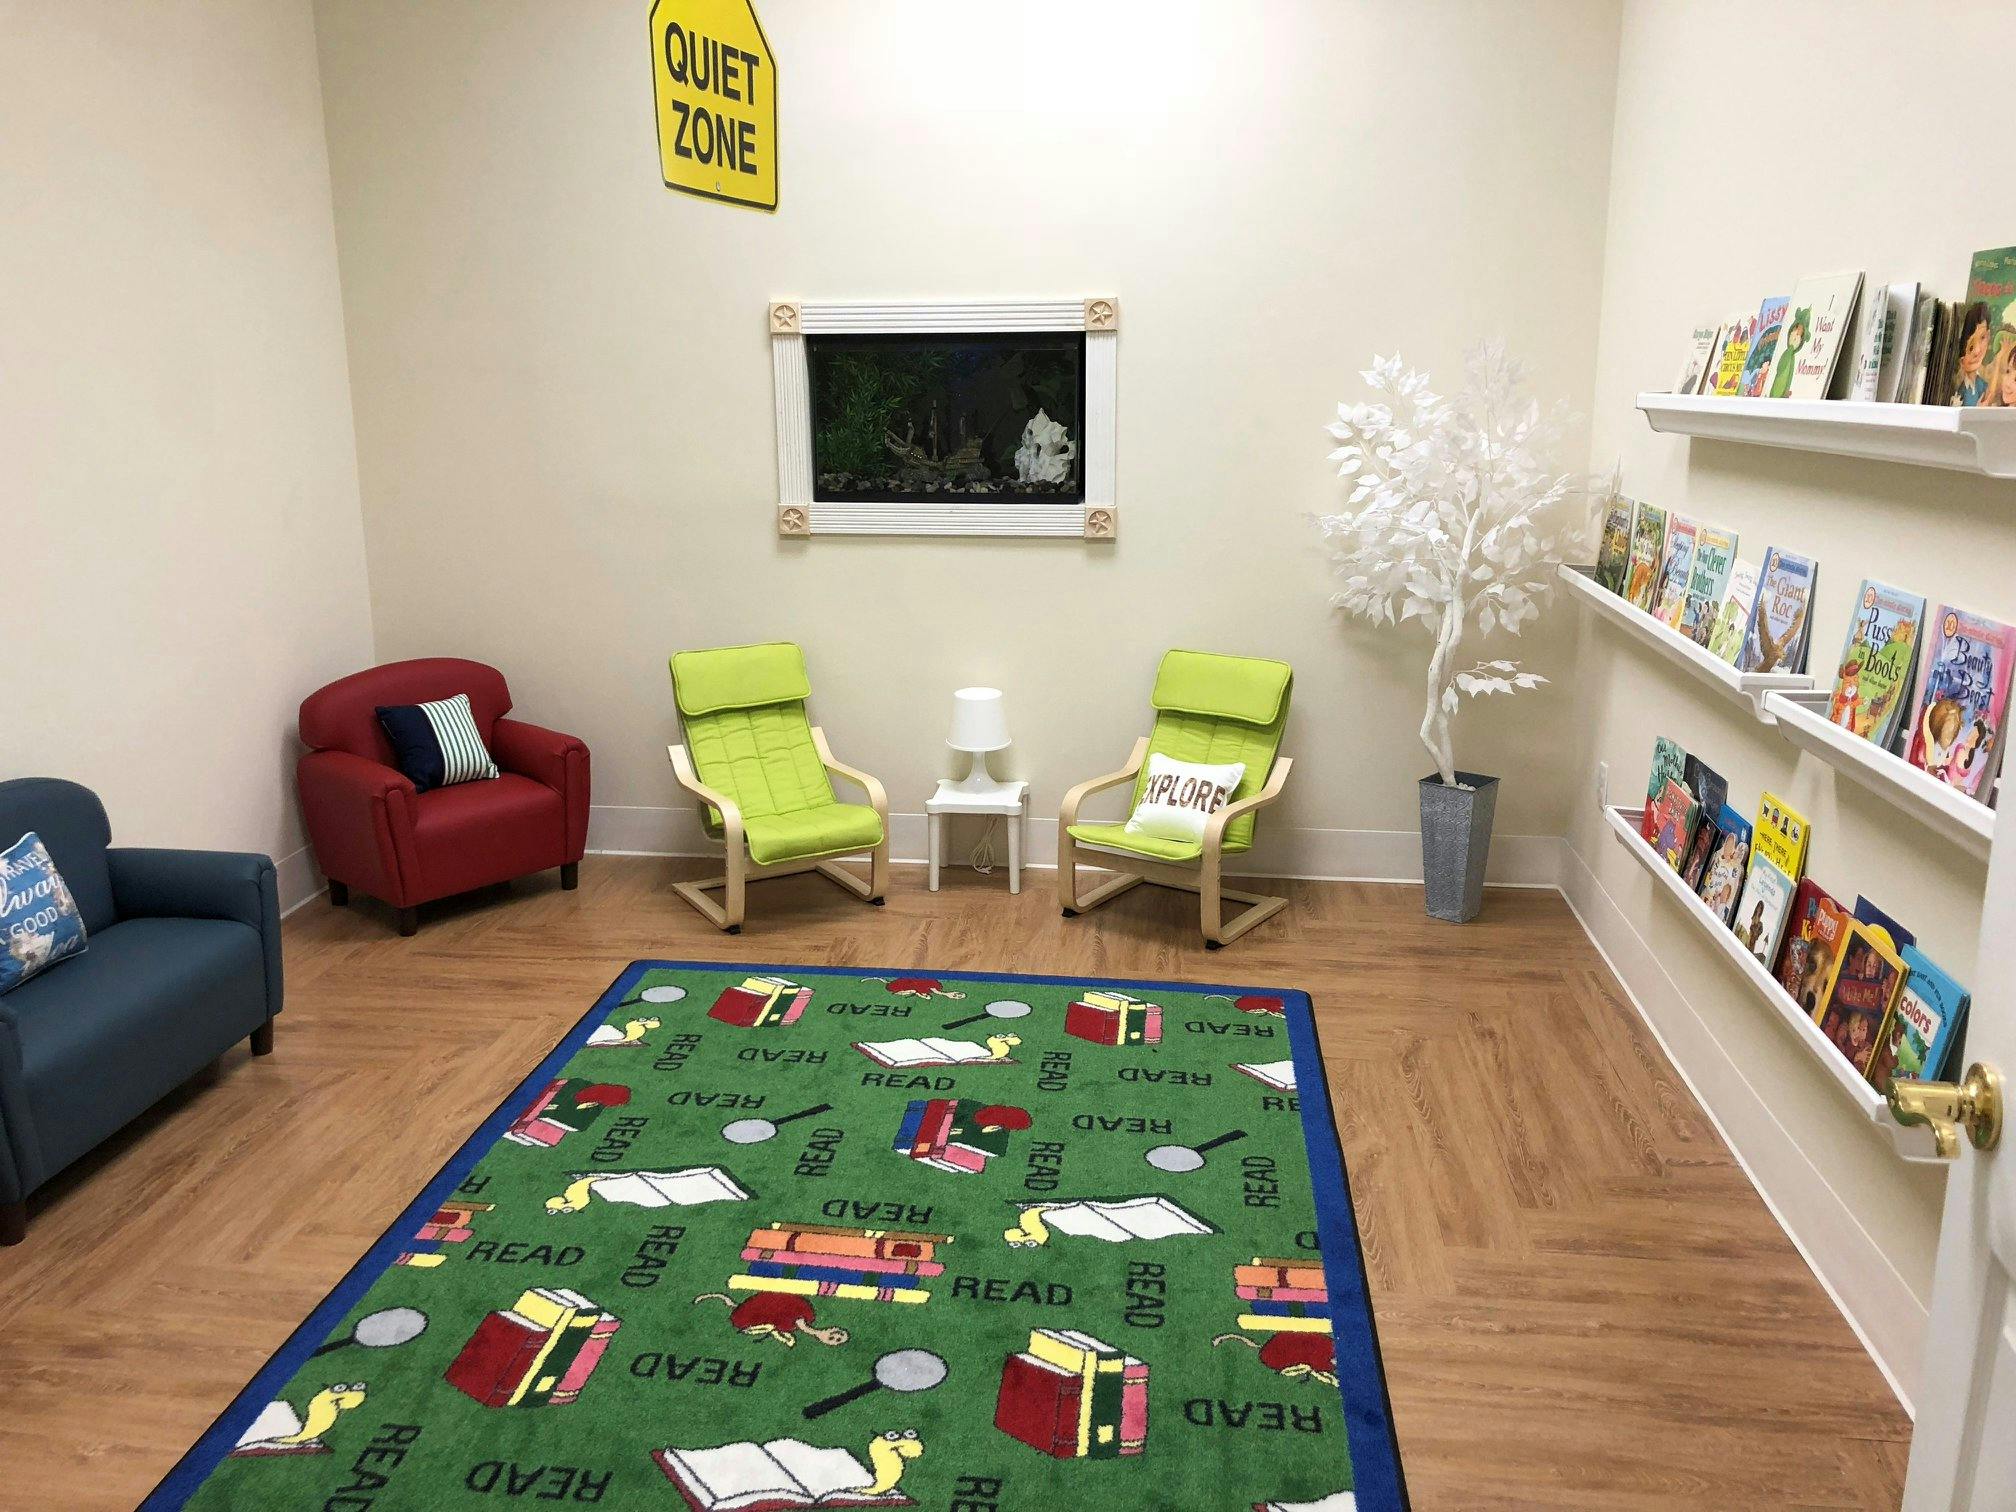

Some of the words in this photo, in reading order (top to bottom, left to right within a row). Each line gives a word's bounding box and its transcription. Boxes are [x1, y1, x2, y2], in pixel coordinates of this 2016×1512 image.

[665, 22, 759, 106] QUIET
[672, 99, 757, 176] ZONE
[1815, 315, 1836, 333] Want
[1811, 337, 1824, 359] My
[1772, 595, 1793, 619] Roc
[1777, 575, 1806, 604] Giant
[1865, 607, 1893, 643] Puss
[1864, 642, 1902, 682] Boots
[1951, 636, 1993, 689] Beauty
[1949, 669, 1995, 711] Beast
[10, 906, 59, 939] GOOD
[827, 1003, 912, 1017] READ
[1900, 996, 1932, 1034] colors
[1185, 1020, 1275, 1038] READ
[653, 1033, 703, 1071] READ
[738, 1047, 828, 1064] READ
[861, 1072, 955, 1091] READ
[1036, 1051, 1072, 1092] READ
[1118, 1067, 1212, 1086] READ
[668, 1090, 766, 1110] READ
[590, 1115, 649, 1163] READ
[1072, 1114, 1173, 1134] READ
[794, 1127, 845, 1177] READ
[1024, 1141, 1065, 1192] READ
[1240, 1155, 1280, 1209] READ
[822, 1199, 934, 1224] READ
[465, 1241, 586, 1267] READ
[621, 1225, 687, 1288] READ
[951, 1275, 1073, 1306] READ
[1124, 1260, 1167, 1329] READ
[630, 1352, 763, 1388] READ
[1183, 1398, 1324, 1434] READ
[465, 1460, 613, 1504] READ
